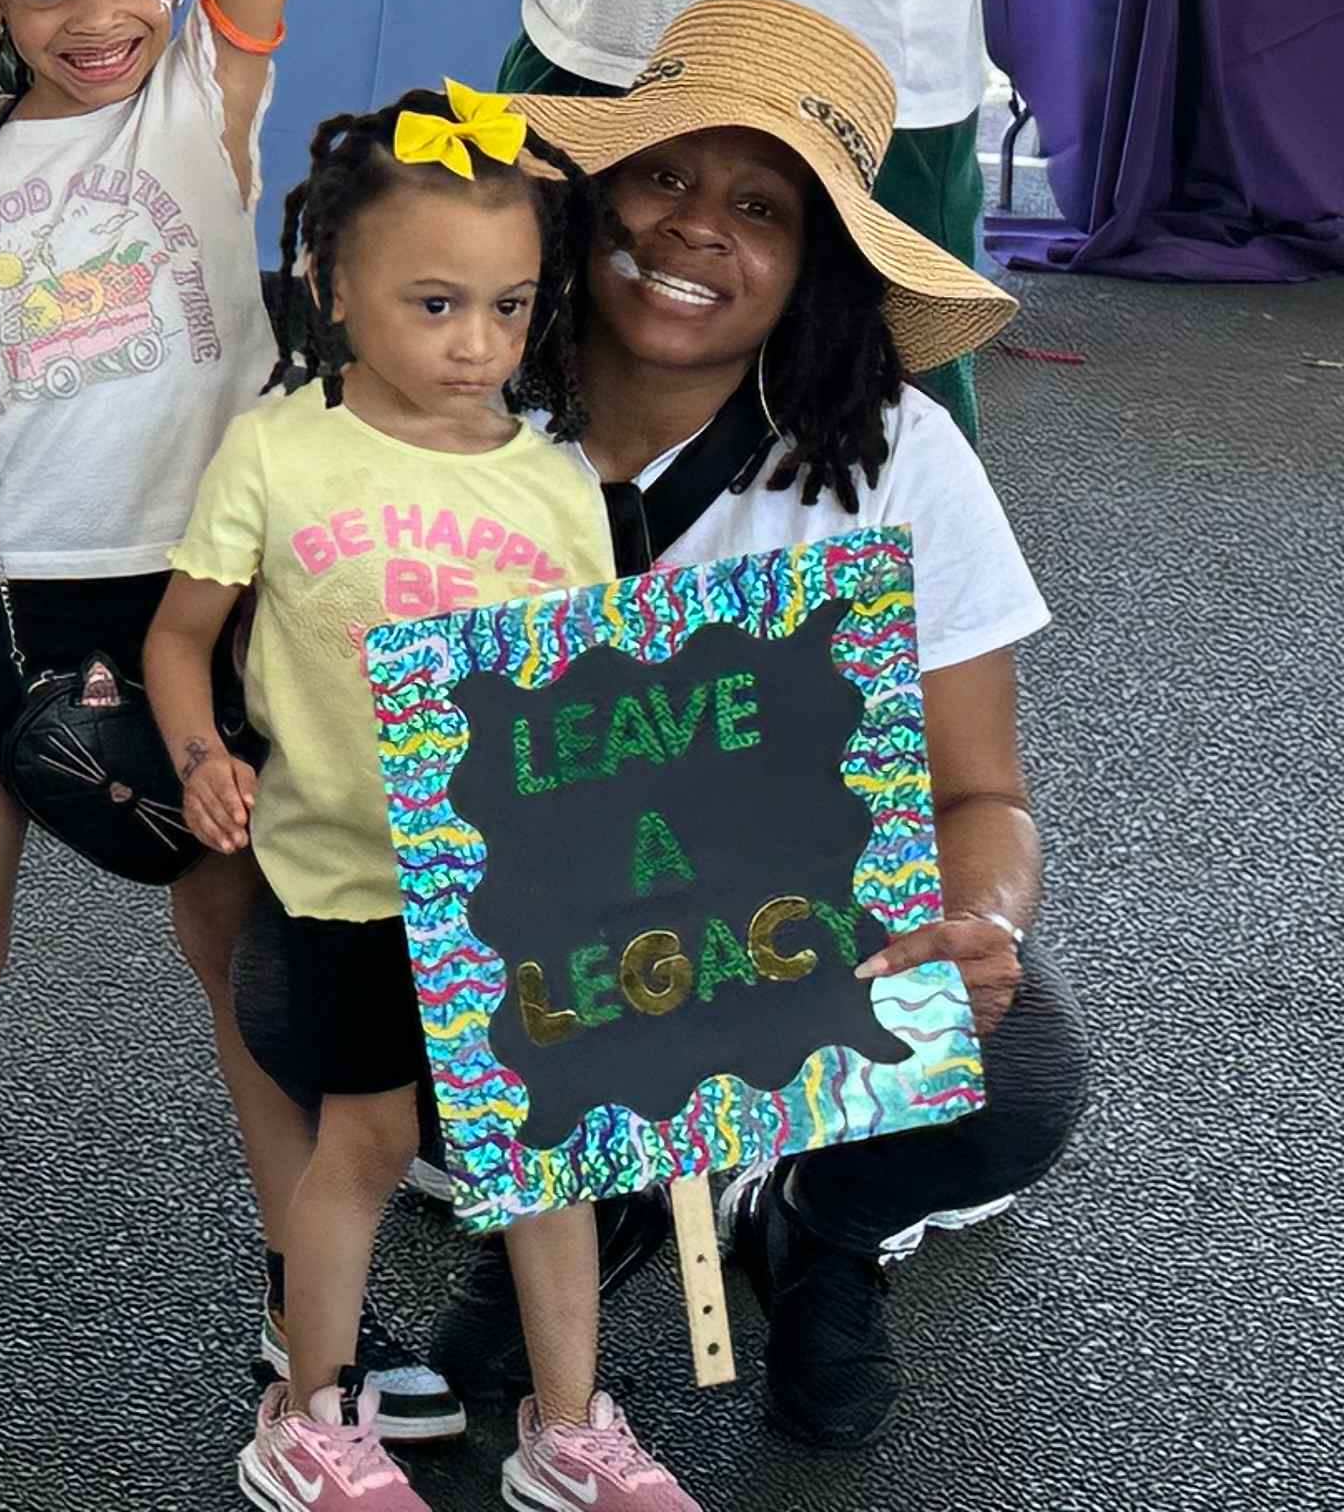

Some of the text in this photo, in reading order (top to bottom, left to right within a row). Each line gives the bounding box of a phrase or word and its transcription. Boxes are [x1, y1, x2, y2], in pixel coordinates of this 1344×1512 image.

[291, 503, 566, 583] BE HAPPY
[384, 557, 480, 617] BE
[514, 671, 762, 796] LEAVE
[630, 811, 698, 896] A
[516, 895, 864, 1048] LEGACY
